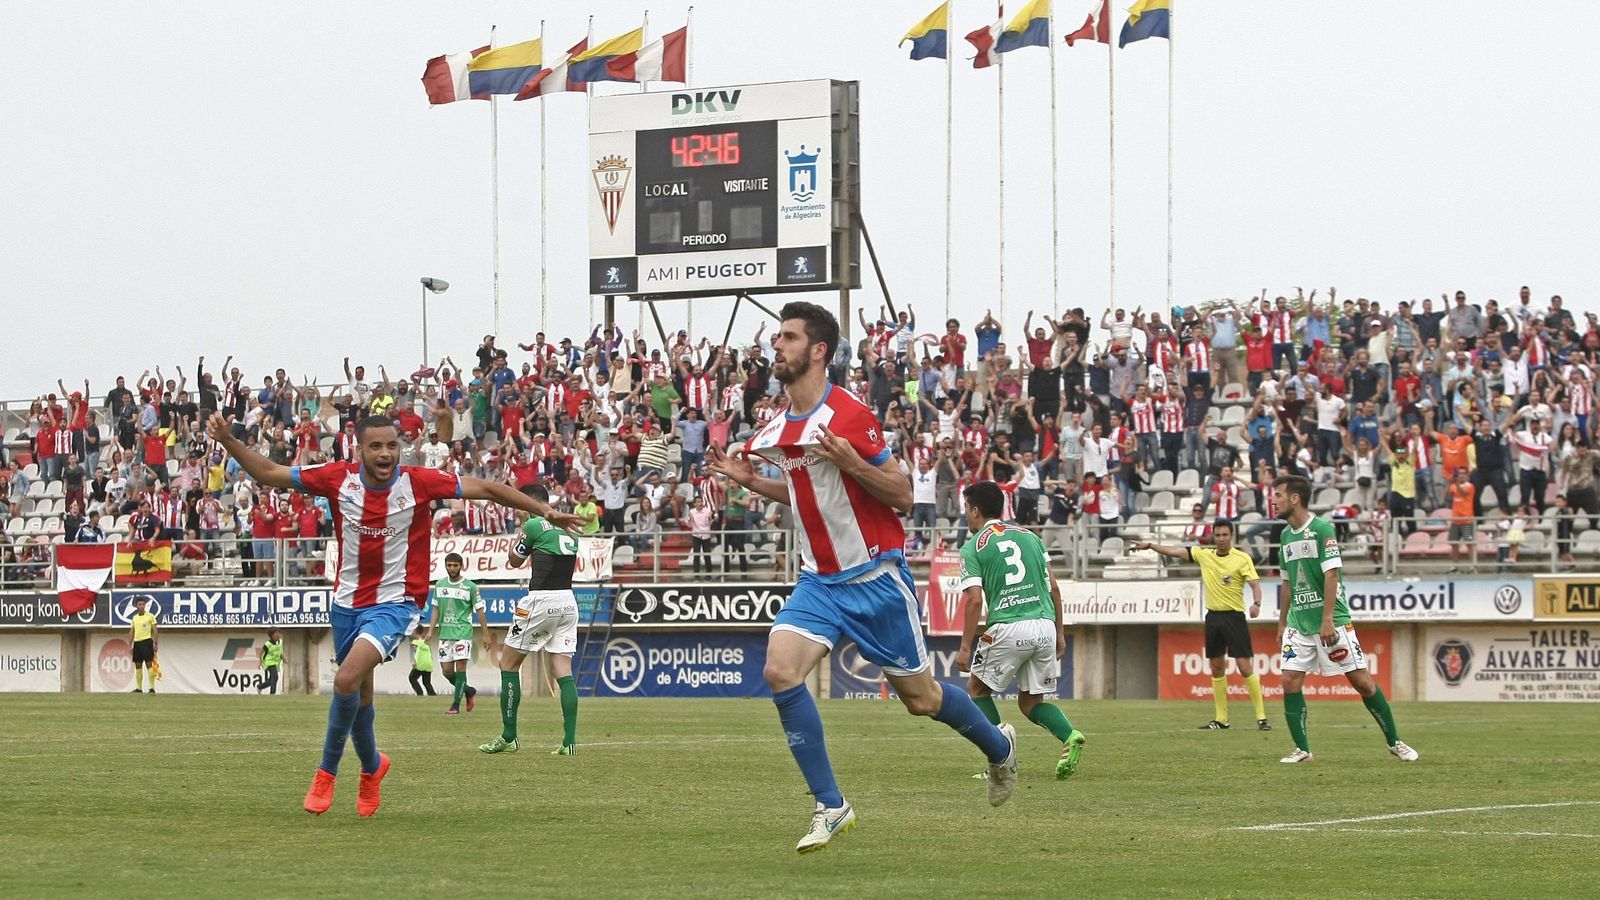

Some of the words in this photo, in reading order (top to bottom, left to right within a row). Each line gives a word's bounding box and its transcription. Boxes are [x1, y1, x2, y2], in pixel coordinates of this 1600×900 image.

[672, 90, 741, 115] DKV
[645, 181, 688, 197] LOCAL
[724, 178, 768, 193] VISITANTE
[781, 203, 826, 213] Ayuntamiento
[793, 211, 822, 221] Algeciras
[683, 234, 727, 246] PERIODO
[647, 267, 679, 281] AMI
[686, 262, 768, 279] PEUGEOT
[477, 556, 499, 574] EL
[996, 540, 1026, 586] 3
[1062, 596, 1117, 614] undado
[1122, 603, 1137, 614] en
[1143, 598, 1181, 614] 1.912
[1294, 591, 1322, 604] HOTEL
[0, 598, 34, 622] hong
[162, 614, 208, 624] ALGECIRAS
[210, 614, 224, 624] 956
[226, 614, 239, 624] 665
[242, 614, 255, 624] 167
[262, 614, 273, 624] LA
[274, 614, 298, 624] LINEA
[300, 614, 314, 623] 956
[316, 614, 329, 623] 643
[1529, 630, 1590, 647] TALLER
[7, 655, 57, 674] logistics
[102, 656, 132, 673] 400
[649, 644, 744, 669] populares
[1486, 645, 1567, 668] ÁLVAREZ
[610, 656, 637, 680] PP
[657, 671, 671, 685] de
[677, 667, 742, 688] Algeciras
[1318, 684, 1331, 695] de
